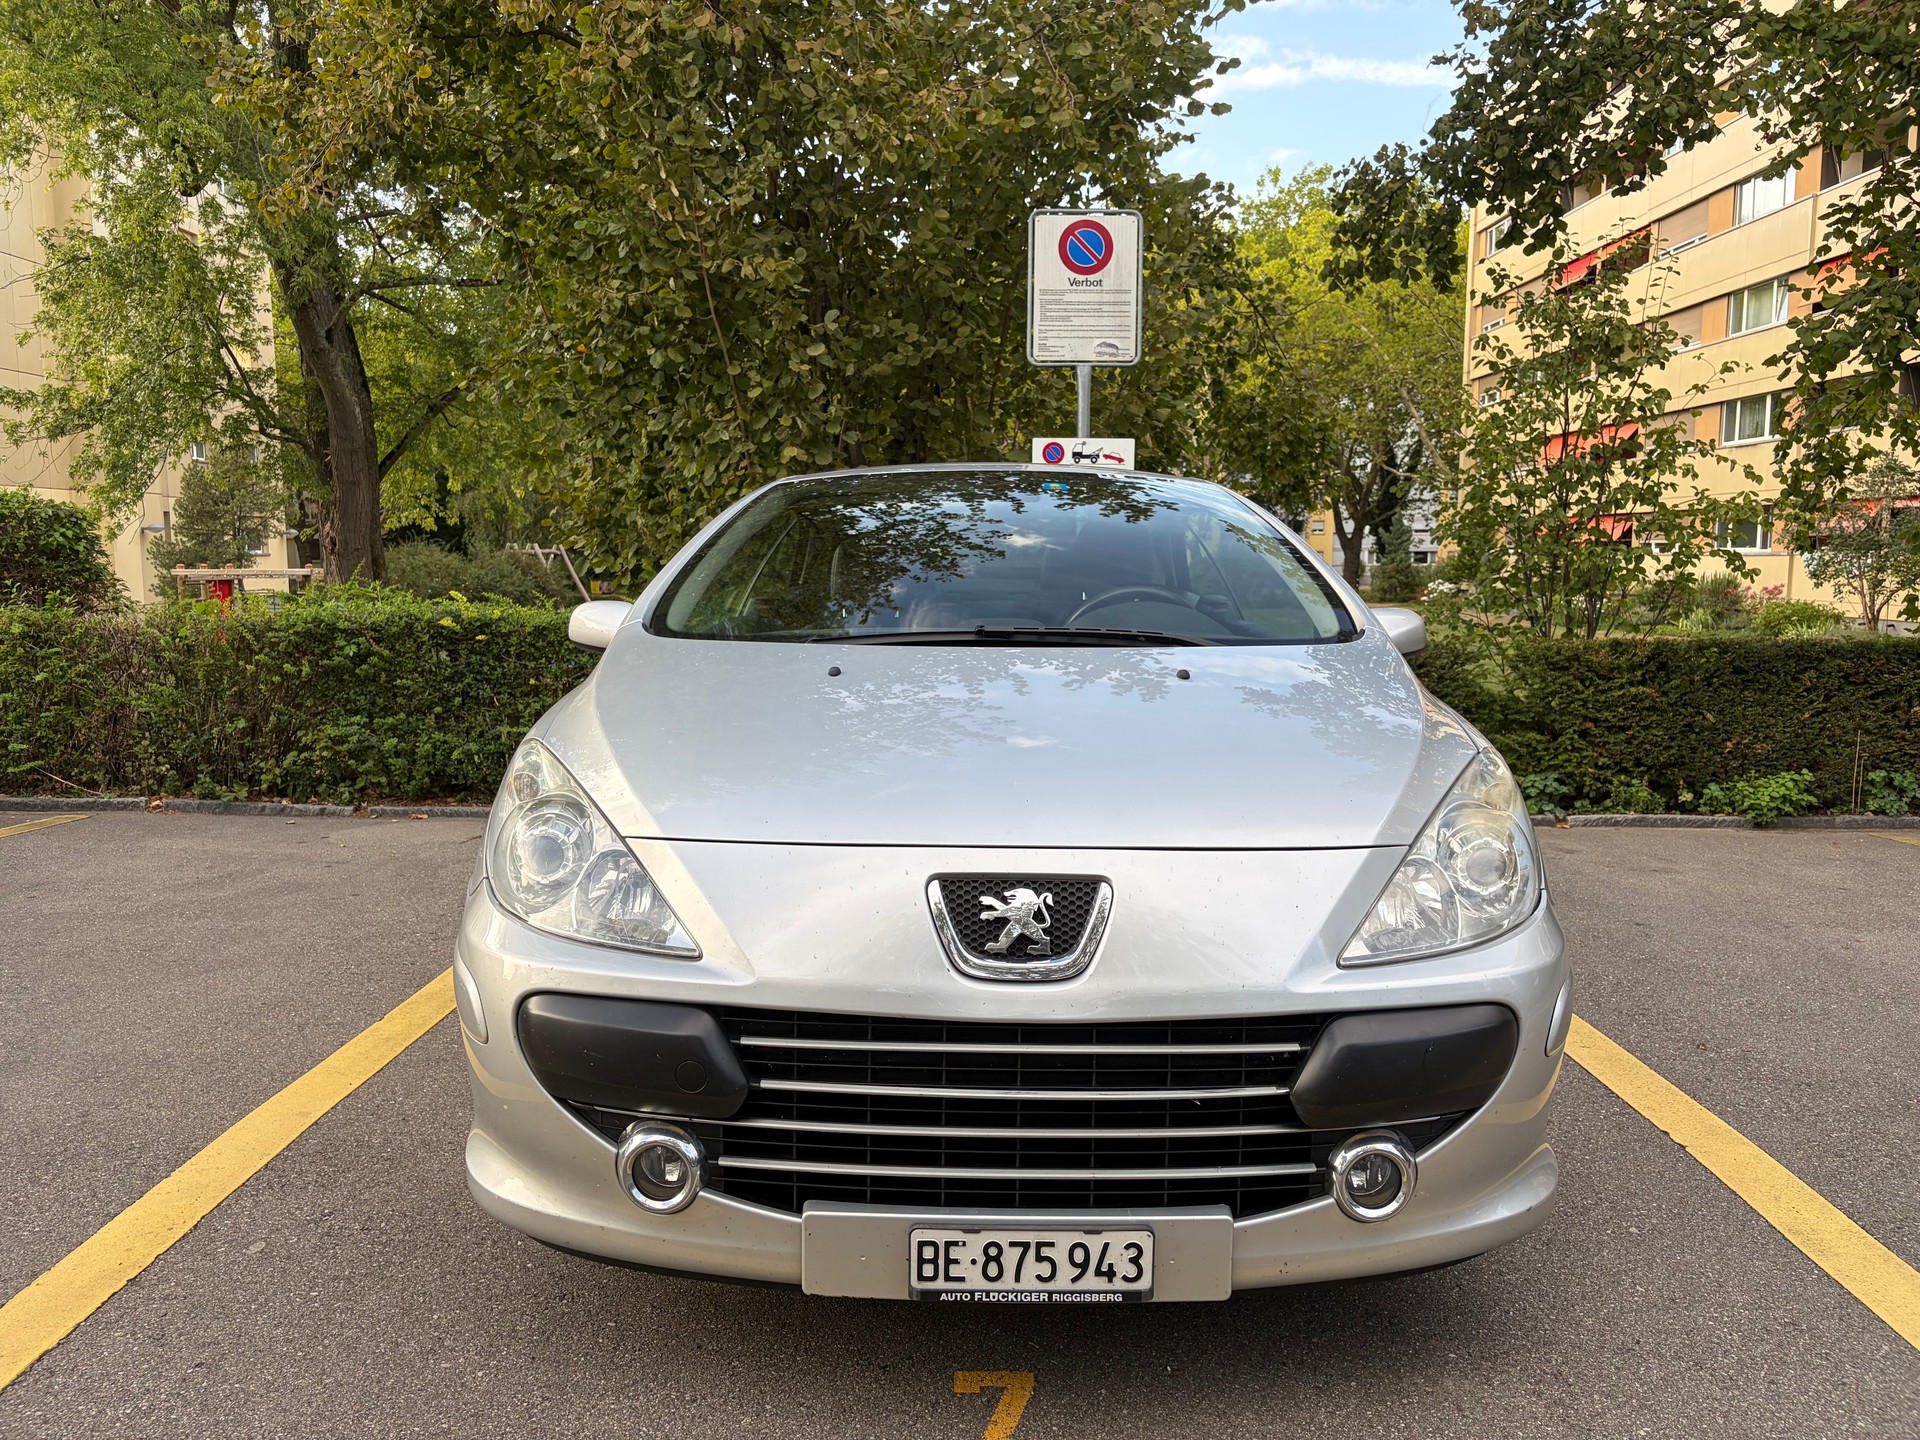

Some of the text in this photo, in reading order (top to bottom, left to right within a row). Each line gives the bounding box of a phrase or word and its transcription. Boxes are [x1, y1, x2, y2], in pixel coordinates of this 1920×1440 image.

[1068, 277, 1103, 287] Verbot
[939, 1292, 1123, 1302] AUTO FLÜCKIGER RIGGISBERG
[954, 1371, 1035, 1440] 7
